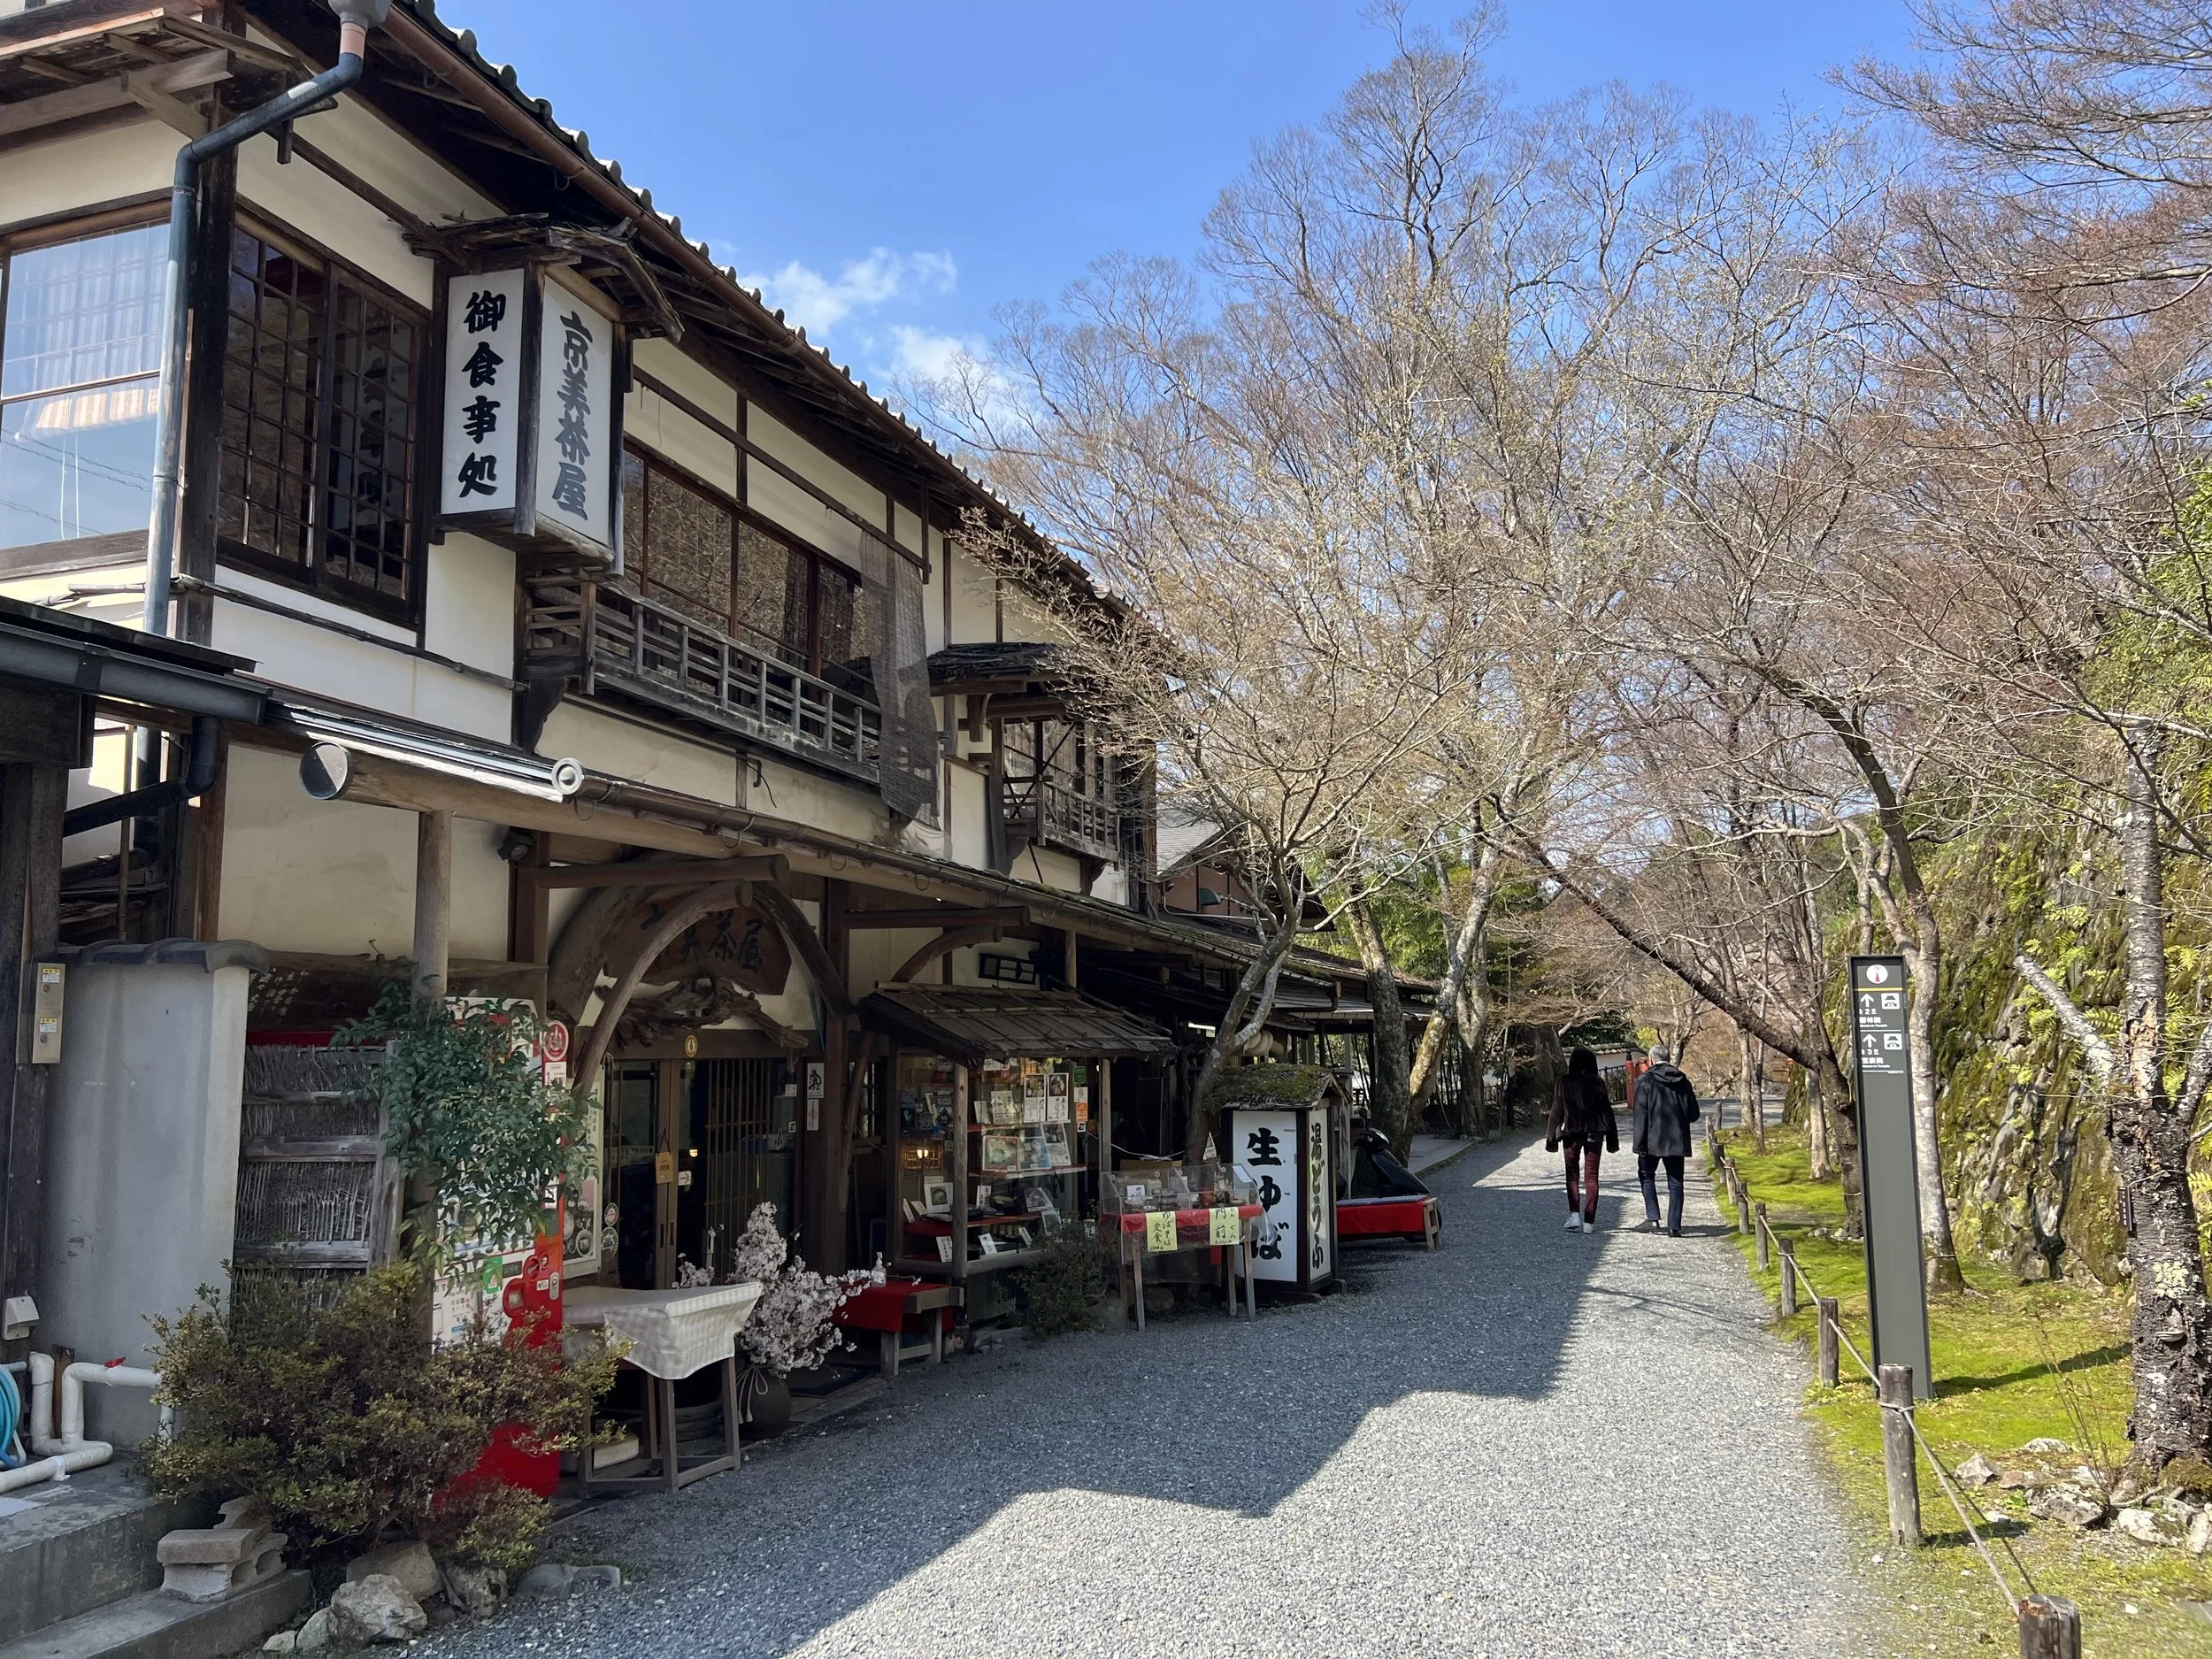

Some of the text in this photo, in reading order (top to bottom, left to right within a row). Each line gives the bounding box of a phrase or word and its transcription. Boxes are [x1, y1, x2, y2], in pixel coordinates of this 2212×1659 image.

[458, 289, 507, 498] 御食事処
[551, 310, 594, 521] 京美茶屋
[1153, 1222, 1163, 1243] 定食
[1162, 1210, 1173, 1246] ゆばそば
[1215, 1208, 1226, 1239] 門前
[1246, 1126, 1289, 1260] 生ゆば
[1310, 1122, 1325, 1270] 湯どうふ
